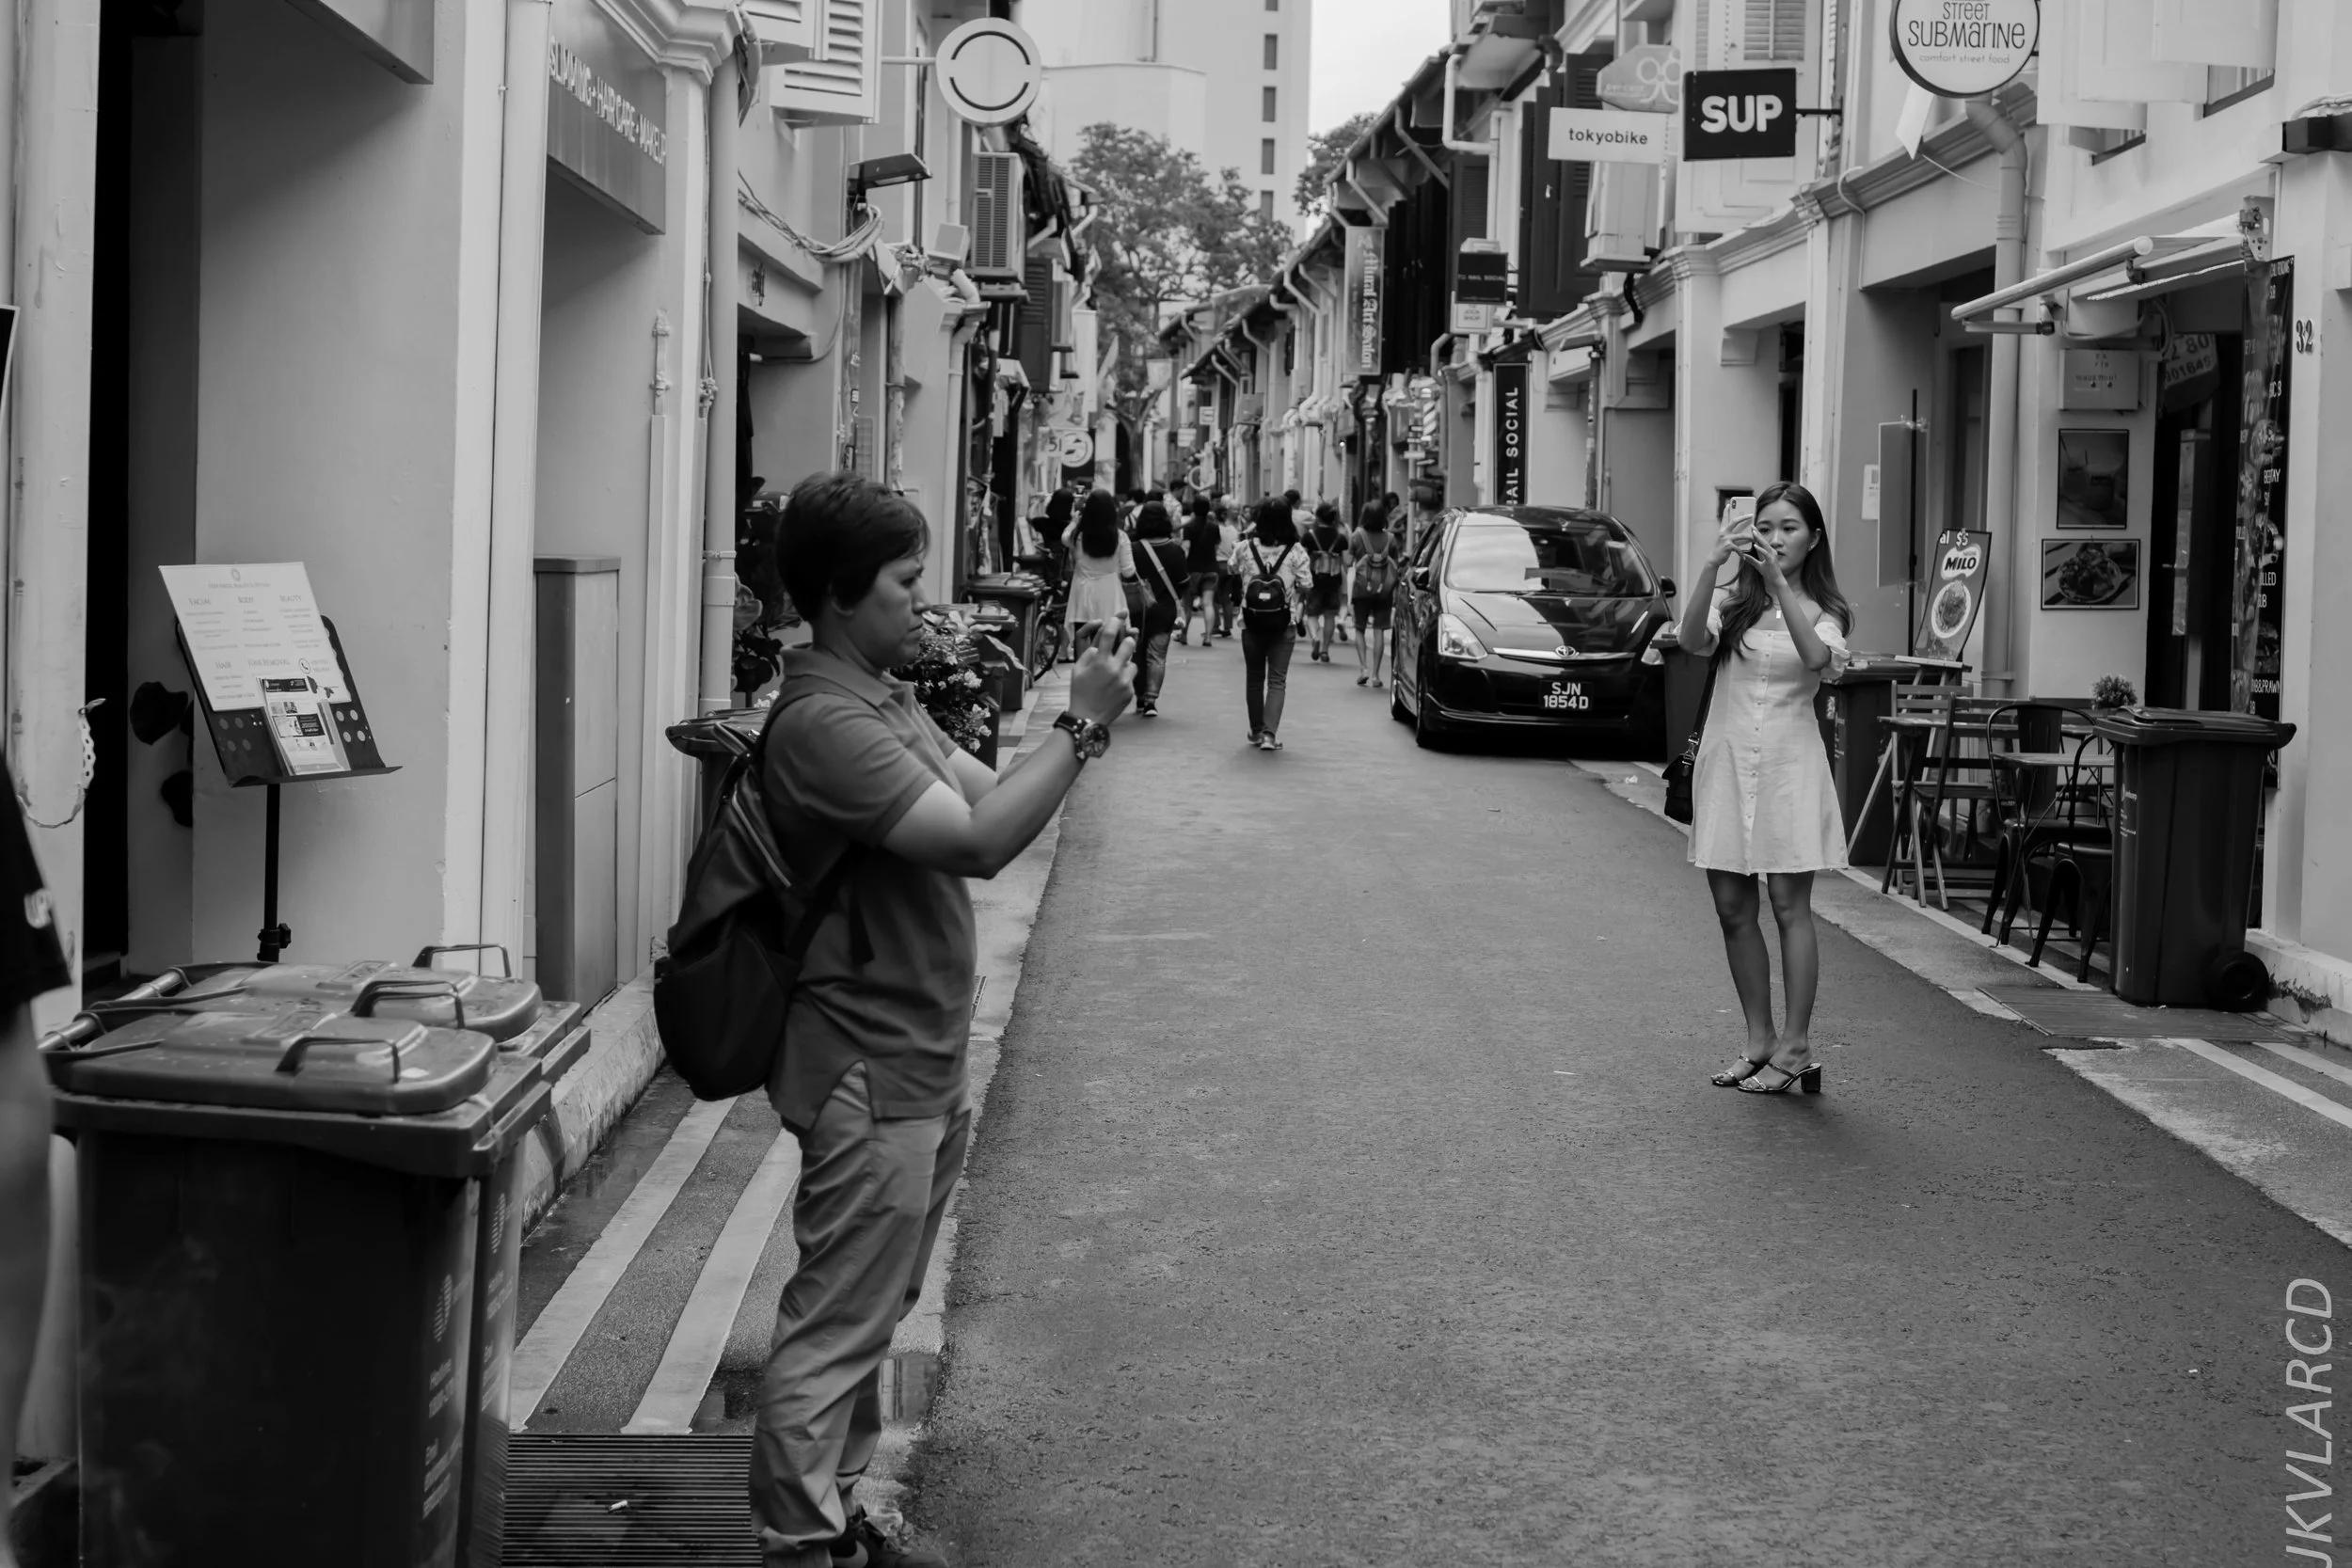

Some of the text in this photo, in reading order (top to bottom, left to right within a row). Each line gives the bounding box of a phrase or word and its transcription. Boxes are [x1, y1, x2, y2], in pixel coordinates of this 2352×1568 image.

[1918, 51, 2010, 64] comfort street food
[1700, 94, 1783, 134] SUP
[1568, 127, 1648, 146] tokyobike
[2296, 319, 2313, 354] 32
[1505, 387, 1519, 457] SOCIAL
[1945, 556, 1977, 571] MILO
[1551, 681, 1581, 695] SJN
[1543, 694, 1589, 709] 1854D
